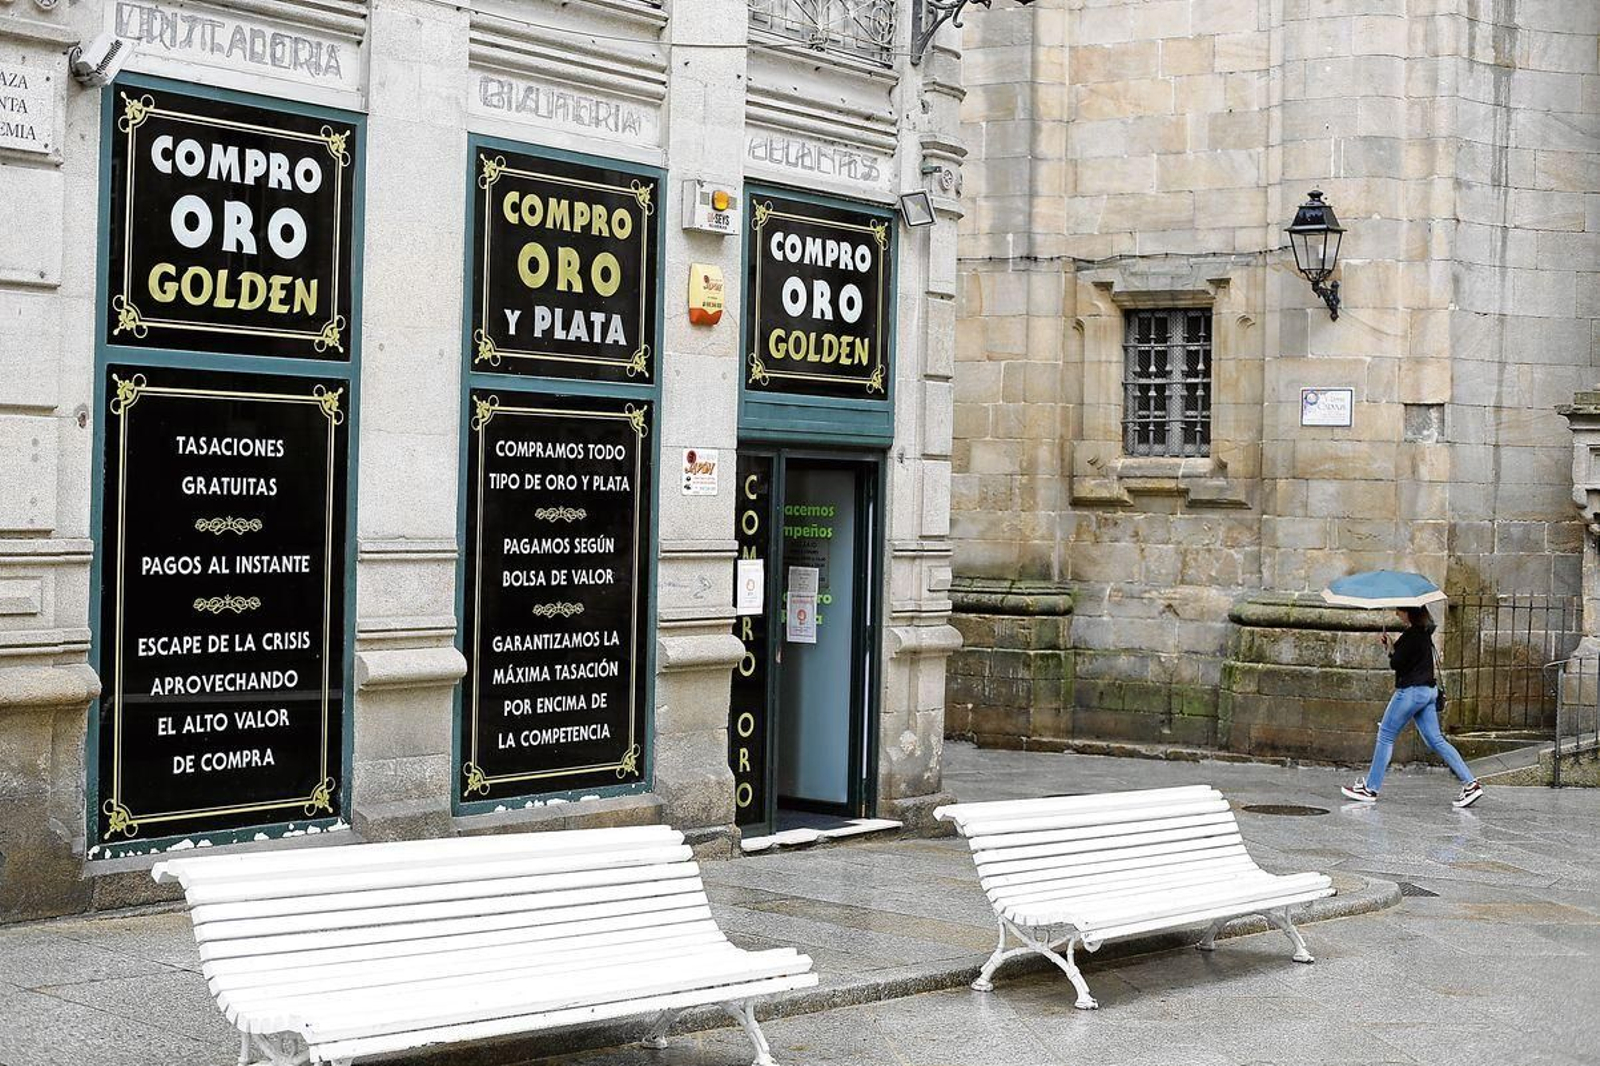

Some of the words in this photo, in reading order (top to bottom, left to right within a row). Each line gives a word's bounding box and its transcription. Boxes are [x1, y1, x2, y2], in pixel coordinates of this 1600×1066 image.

[151, 135, 322, 194] COMPRO
[171, 195, 307, 260] ORO
[503, 191, 632, 240] COMPRO
[771, 231, 872, 273] COMPRO
[518, 242, 620, 296] ORO
[149, 263, 317, 315] GOLDEN
[782, 276, 862, 323] ORO
[504, 309, 521, 335] Y
[534, 306, 627, 345] PLATA
[769, 329, 869, 366] GOLDEN
[177, 436, 284, 457] TASACIONES
[496, 441, 583, 459] COMPRAMOS
[588, 444, 625, 460] TODO
[182, 476, 277, 495] GRATUITAS
[489, 473, 519, 489] TIPO
[525, 474, 541, 489] DE
[546, 475, 577, 490] ORO
[582, 476, 589, 490] Y
[593, 476, 629, 491] PLATA
[785, 504, 834, 518] acemos
[504, 538, 570, 554] PAGAMOS
[575, 535, 614, 553] SEGÚN
[142, 556, 201, 575] PAGOS
[208, 556, 229, 573] AL
[236, 556, 310, 573] INSTANTE
[503, 571, 546, 586] BOLSA
[551, 570, 567, 585] DE
[572, 569, 613, 584] VALOR
[139, 636, 201, 656] ESCAPE
[209, 635, 229, 652] DE
[235, 634, 255, 651] LA
[263, 632, 310, 650] CRISIS
[493, 632, 599, 652] GARANTIZAMOS
[604, 631, 619, 645] LA
[151, 670, 298, 696] APROVECHANDO
[493, 664, 550, 684] MÁXIMA
[555, 659, 618, 680] TASACIÓN
[504, 699, 531, 716] POR
[537, 695, 586, 713] ENCIMA
[592, 693, 607, 708] DE
[158, 717, 176, 735] EL
[183, 713, 228, 733] ALTO
[235, 709, 289, 729] VALOR
[499, 733, 515, 749] LA
[521, 724, 610, 746] COMPETENCIA
[174, 755, 194, 774] DE
[201, 748, 274, 771] COMPRA
